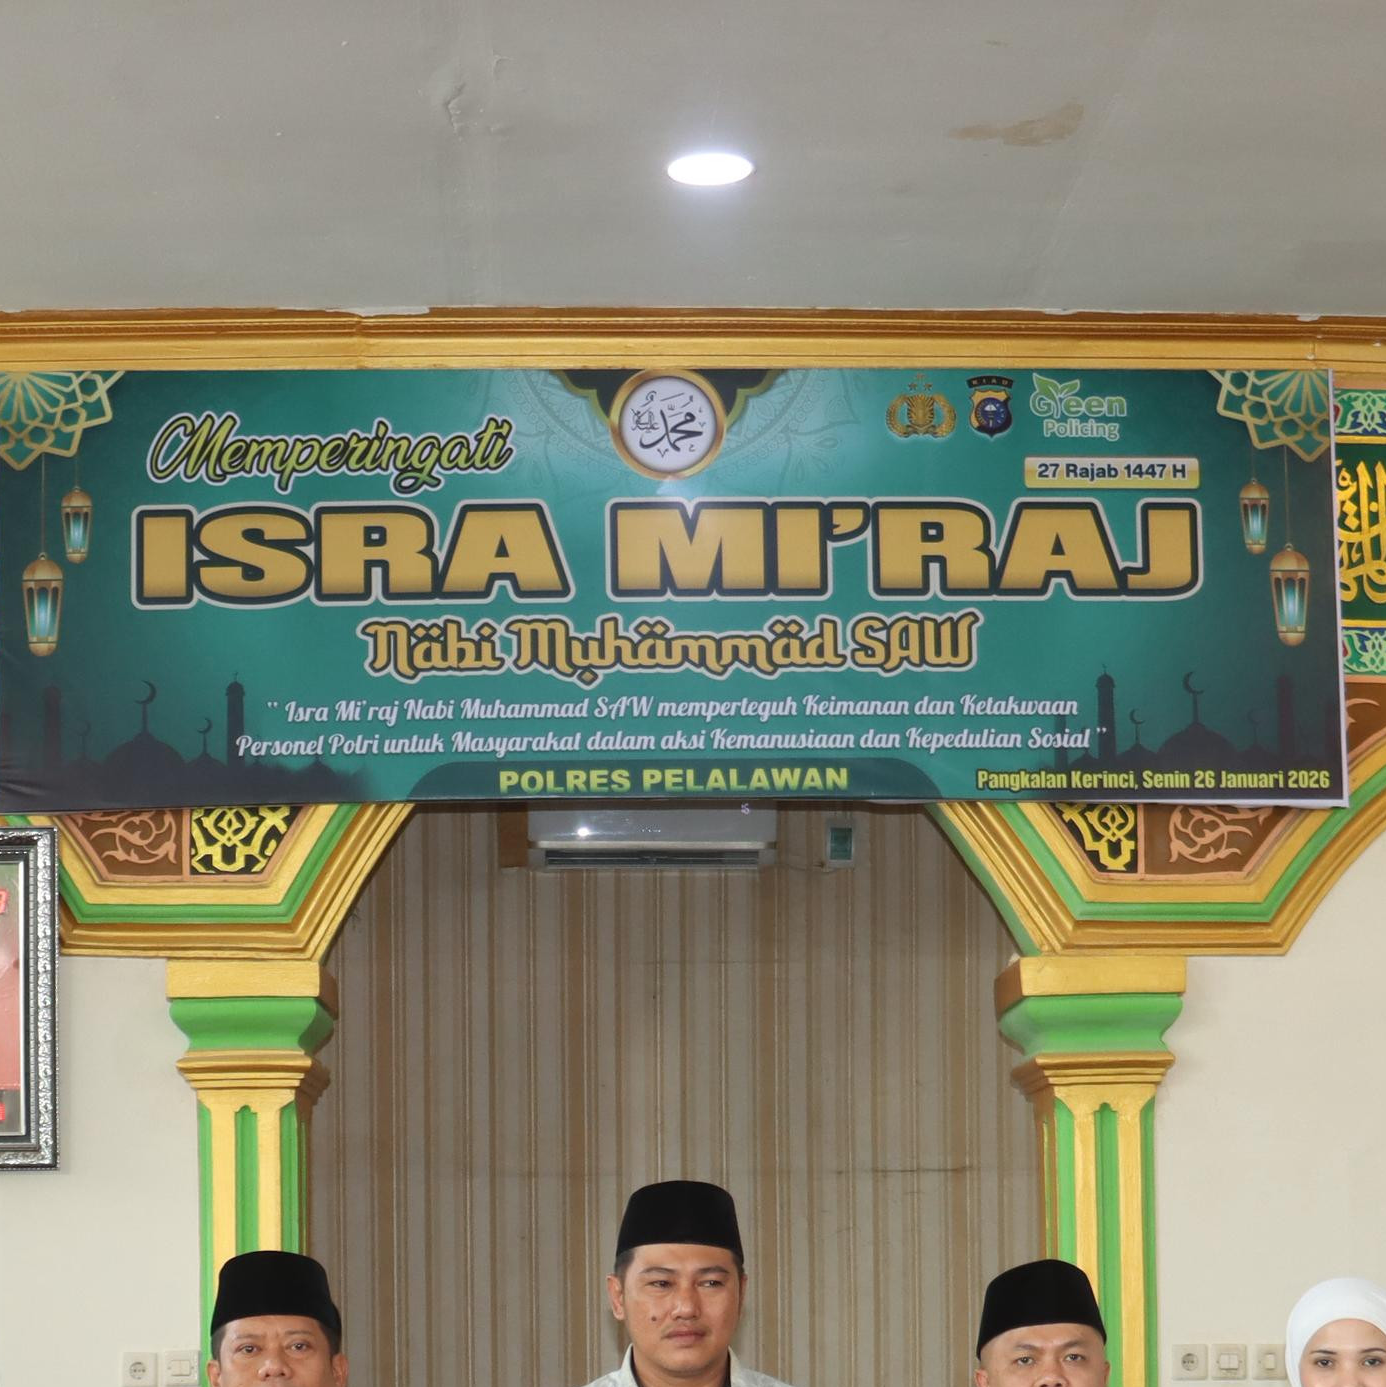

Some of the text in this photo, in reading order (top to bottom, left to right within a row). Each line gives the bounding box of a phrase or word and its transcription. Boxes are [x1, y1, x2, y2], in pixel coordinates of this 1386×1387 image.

[1029, 384, 1127, 418] Green
[1044, 419, 1120, 441] Policing
[148, 413, 513, 494] Memperingati
[1037, 462, 1186, 482] 27 Rajab 1447 H
[137, 499, 1199, 605] ISRA MI'RAJ
[850, 608, 983, 672] SAW
[285, 701, 328, 722] Isra
[403, 699, 454, 721] Nabi
[460, 698, 589, 720] Muhammad
[594, 696, 654, 720] SAW
[657, 695, 797, 722] memperteguh
[803, 694, 909, 716] Keimanan
[914, 695, 955, 716] dan
[960, 693, 1078, 716] Ketakwaan
[236, 727, 1090, 758] Personel Polri untuk Masyarakat dalam aksi Kemanusiaan dan Kepedulian Sosial
[499, 766, 848, 795] POLRES PELALAWAN
[977, 769, 1330, 792] Pangkalan Kerinci, Senin 26 Januari 2026
